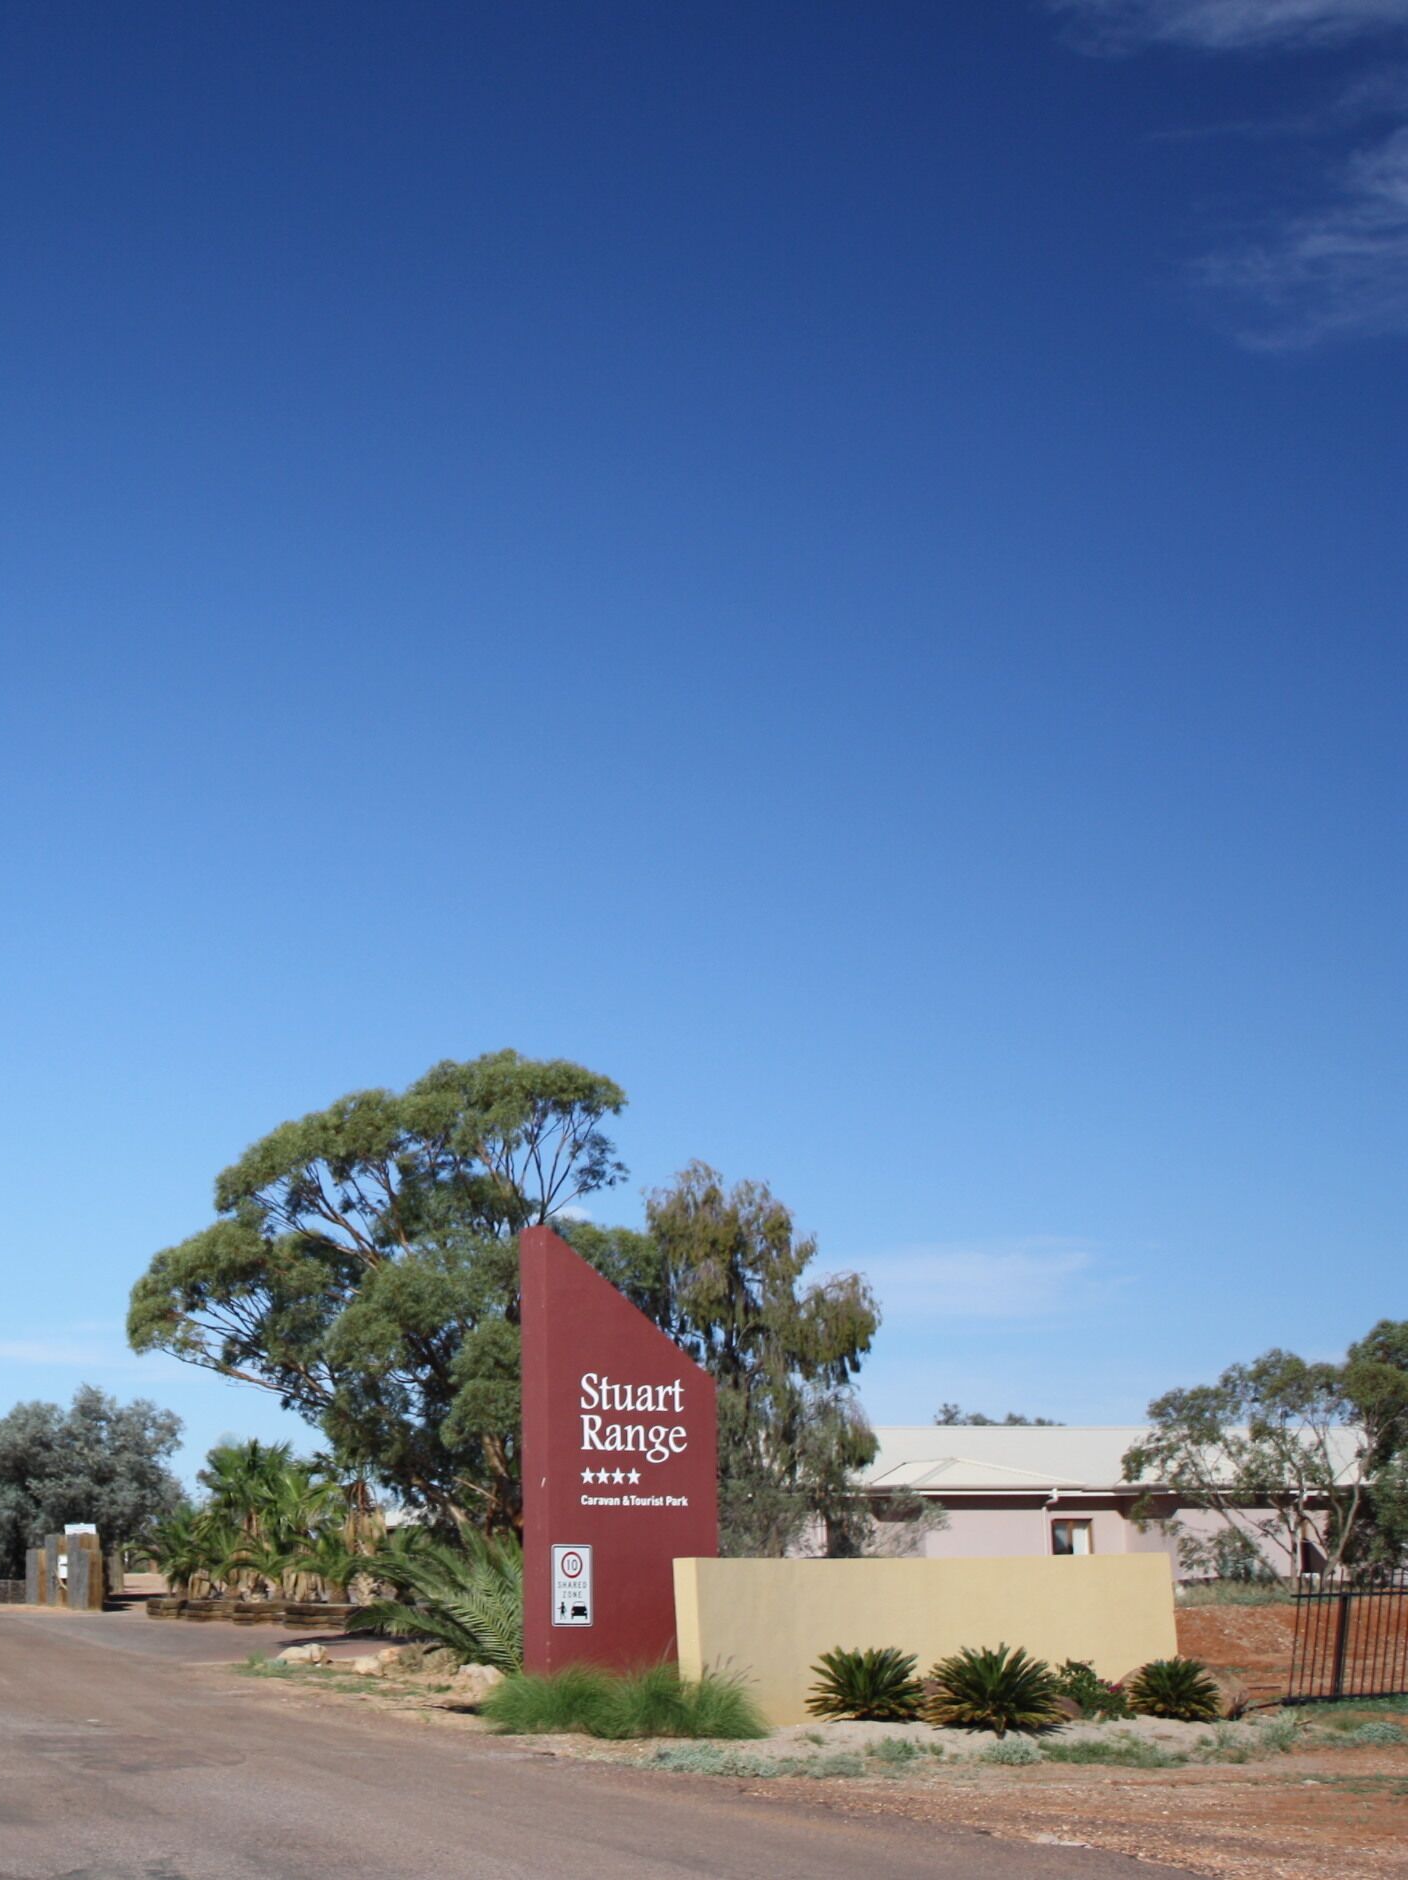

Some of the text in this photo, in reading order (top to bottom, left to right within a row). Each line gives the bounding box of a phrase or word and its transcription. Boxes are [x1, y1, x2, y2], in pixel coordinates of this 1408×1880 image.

[580, 1372, 685, 1413] Stuart
[579, 1414, 688, 1464] Range
[580, 1494, 620, 1505] Caravan
[665, 1496, 689, 1507] Park
[566, 1558, 579, 1571] 10
[557, 1581, 587, 1589] SHARED
[562, 1591, 583, 1599] ZONE
